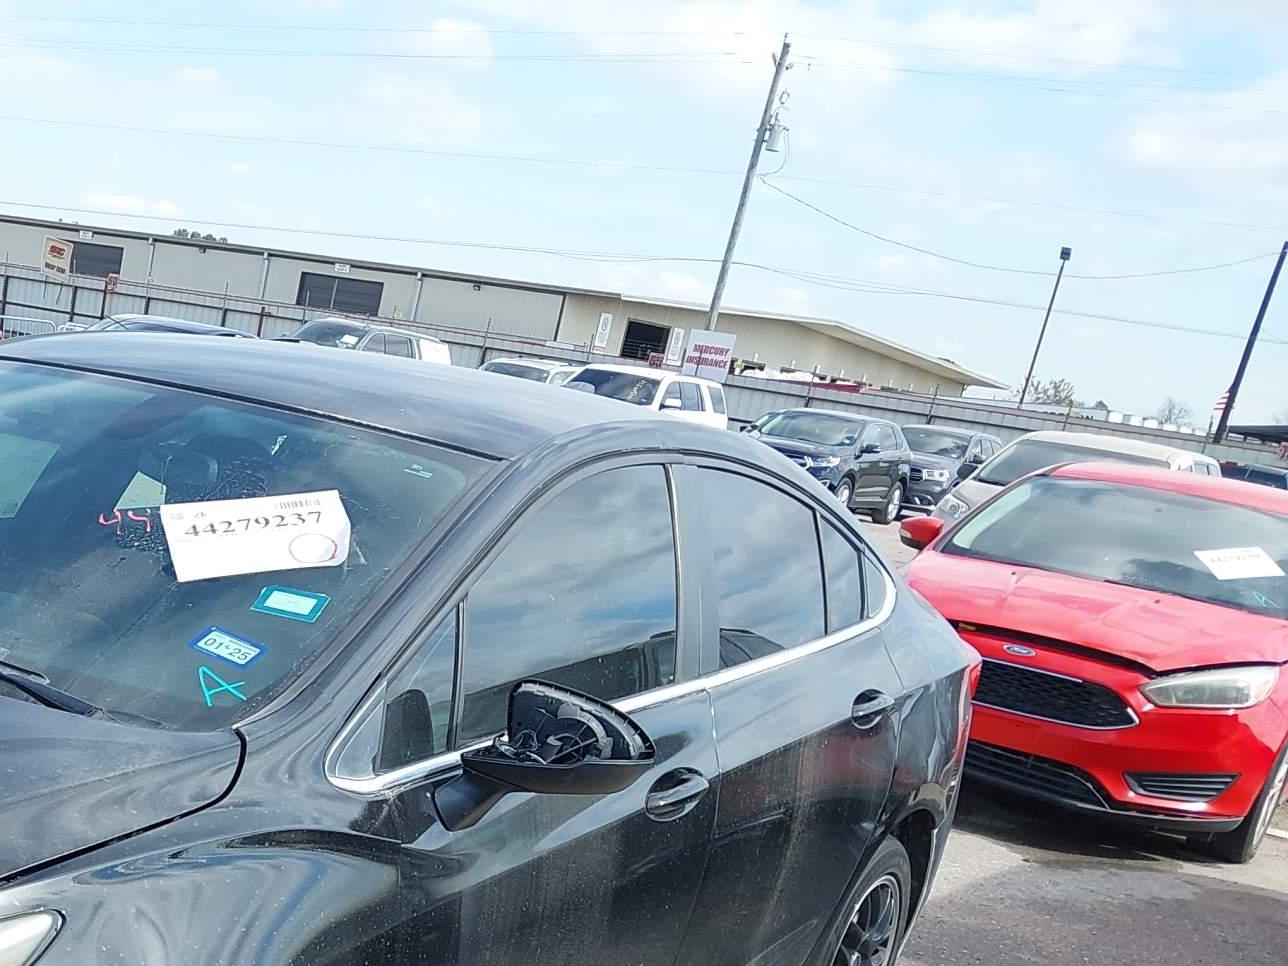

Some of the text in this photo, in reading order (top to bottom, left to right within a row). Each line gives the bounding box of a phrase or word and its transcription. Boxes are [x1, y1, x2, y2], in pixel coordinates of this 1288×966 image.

[692, 344, 730, 357] MERCURY
[686, 355, 728, 369] INSURANCE
[184, 511, 323, 537] 44279237
